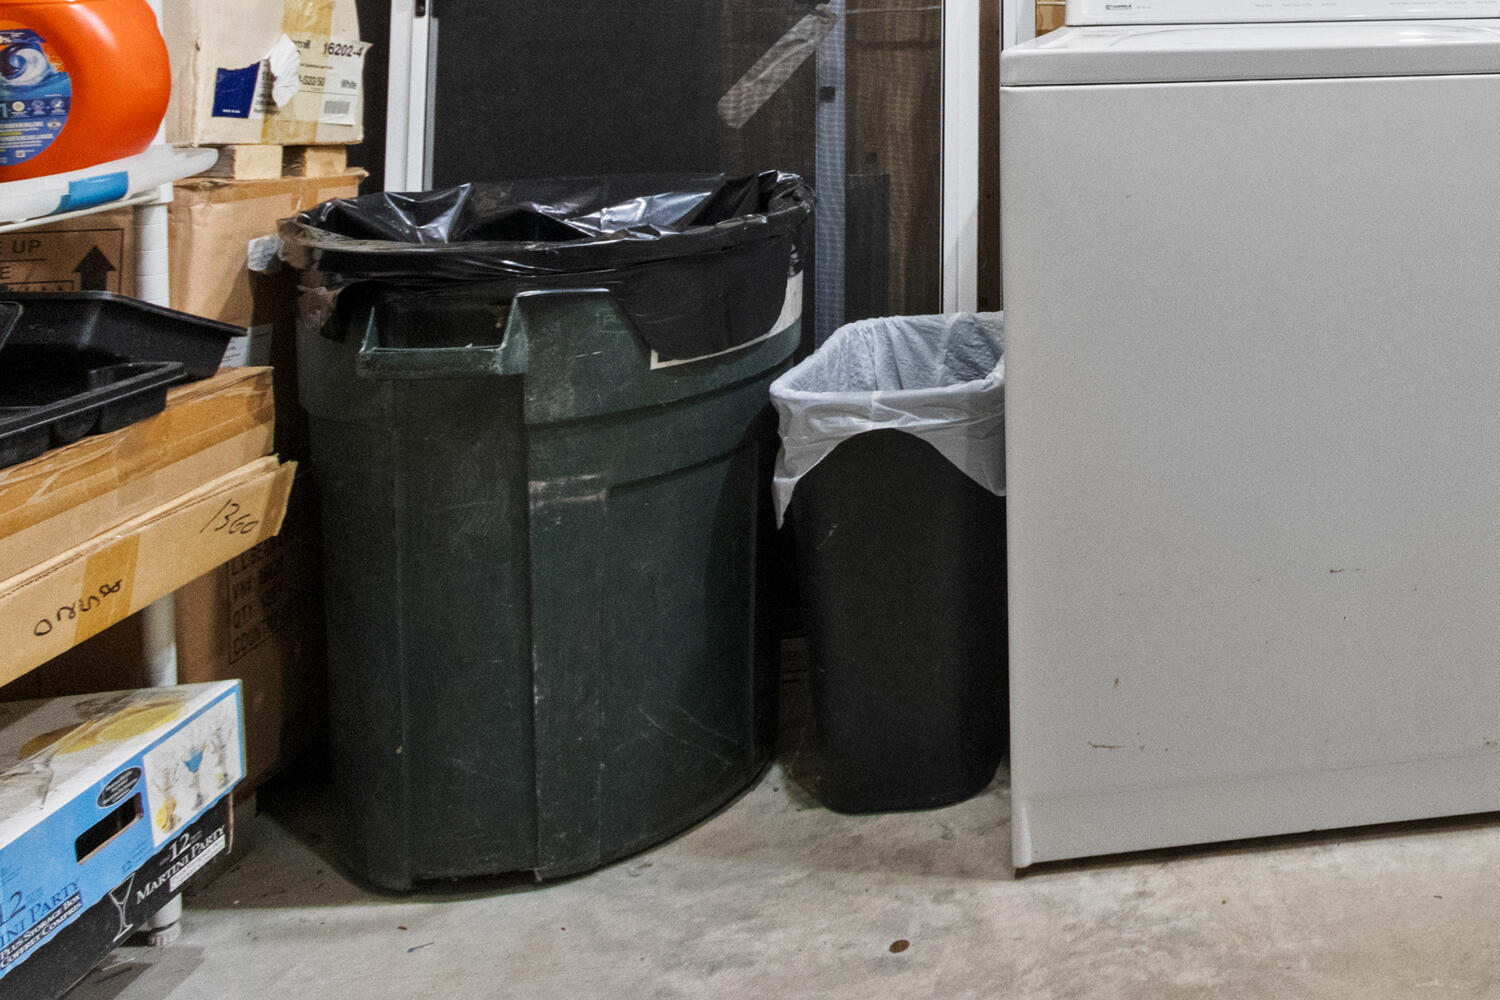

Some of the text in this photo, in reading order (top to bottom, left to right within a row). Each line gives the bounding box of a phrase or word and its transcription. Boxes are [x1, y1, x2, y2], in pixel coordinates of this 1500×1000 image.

[12, 239, 42, 254] UP
[169, 833, 192, 862] 12
[136, 855, 190, 904] MARTINI
[190, 824, 225, 859] PARTY
